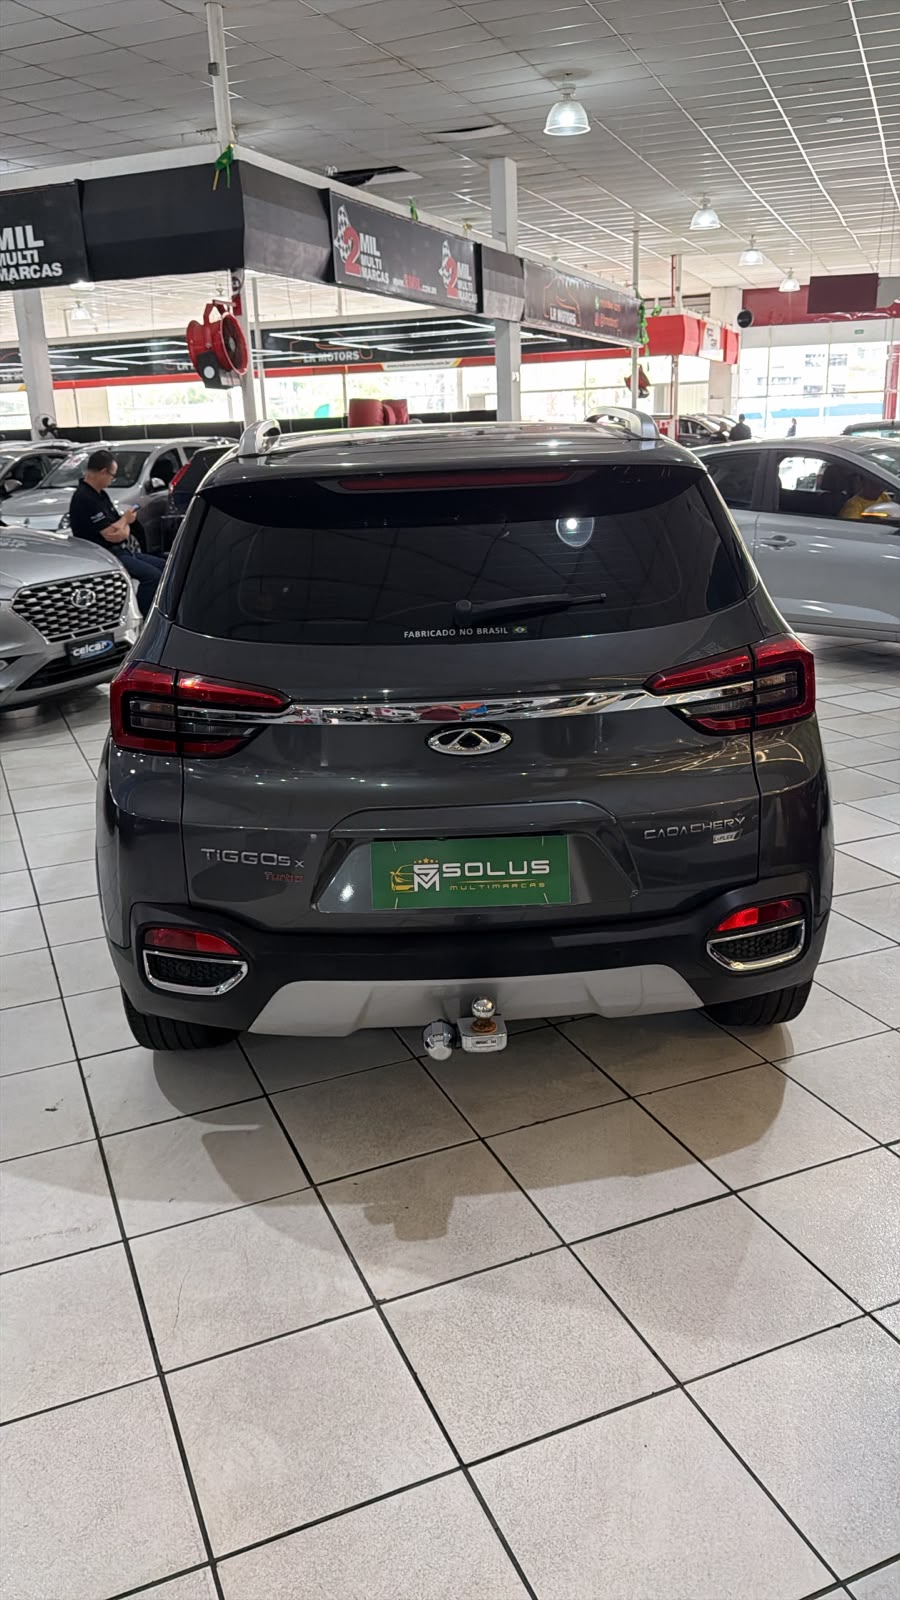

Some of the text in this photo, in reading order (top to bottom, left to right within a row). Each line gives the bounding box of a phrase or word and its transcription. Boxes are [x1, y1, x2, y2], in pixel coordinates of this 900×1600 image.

[0, 224, 45, 251] MIL
[359, 232, 381, 257] MIL
[361, 267, 390, 285] MARCAS
[403, 626, 509, 639] FABRICADO NO BRASIL
[442, 859, 551, 878] SOLUS
[449, 881, 546, 892] MULTIMARCAS
